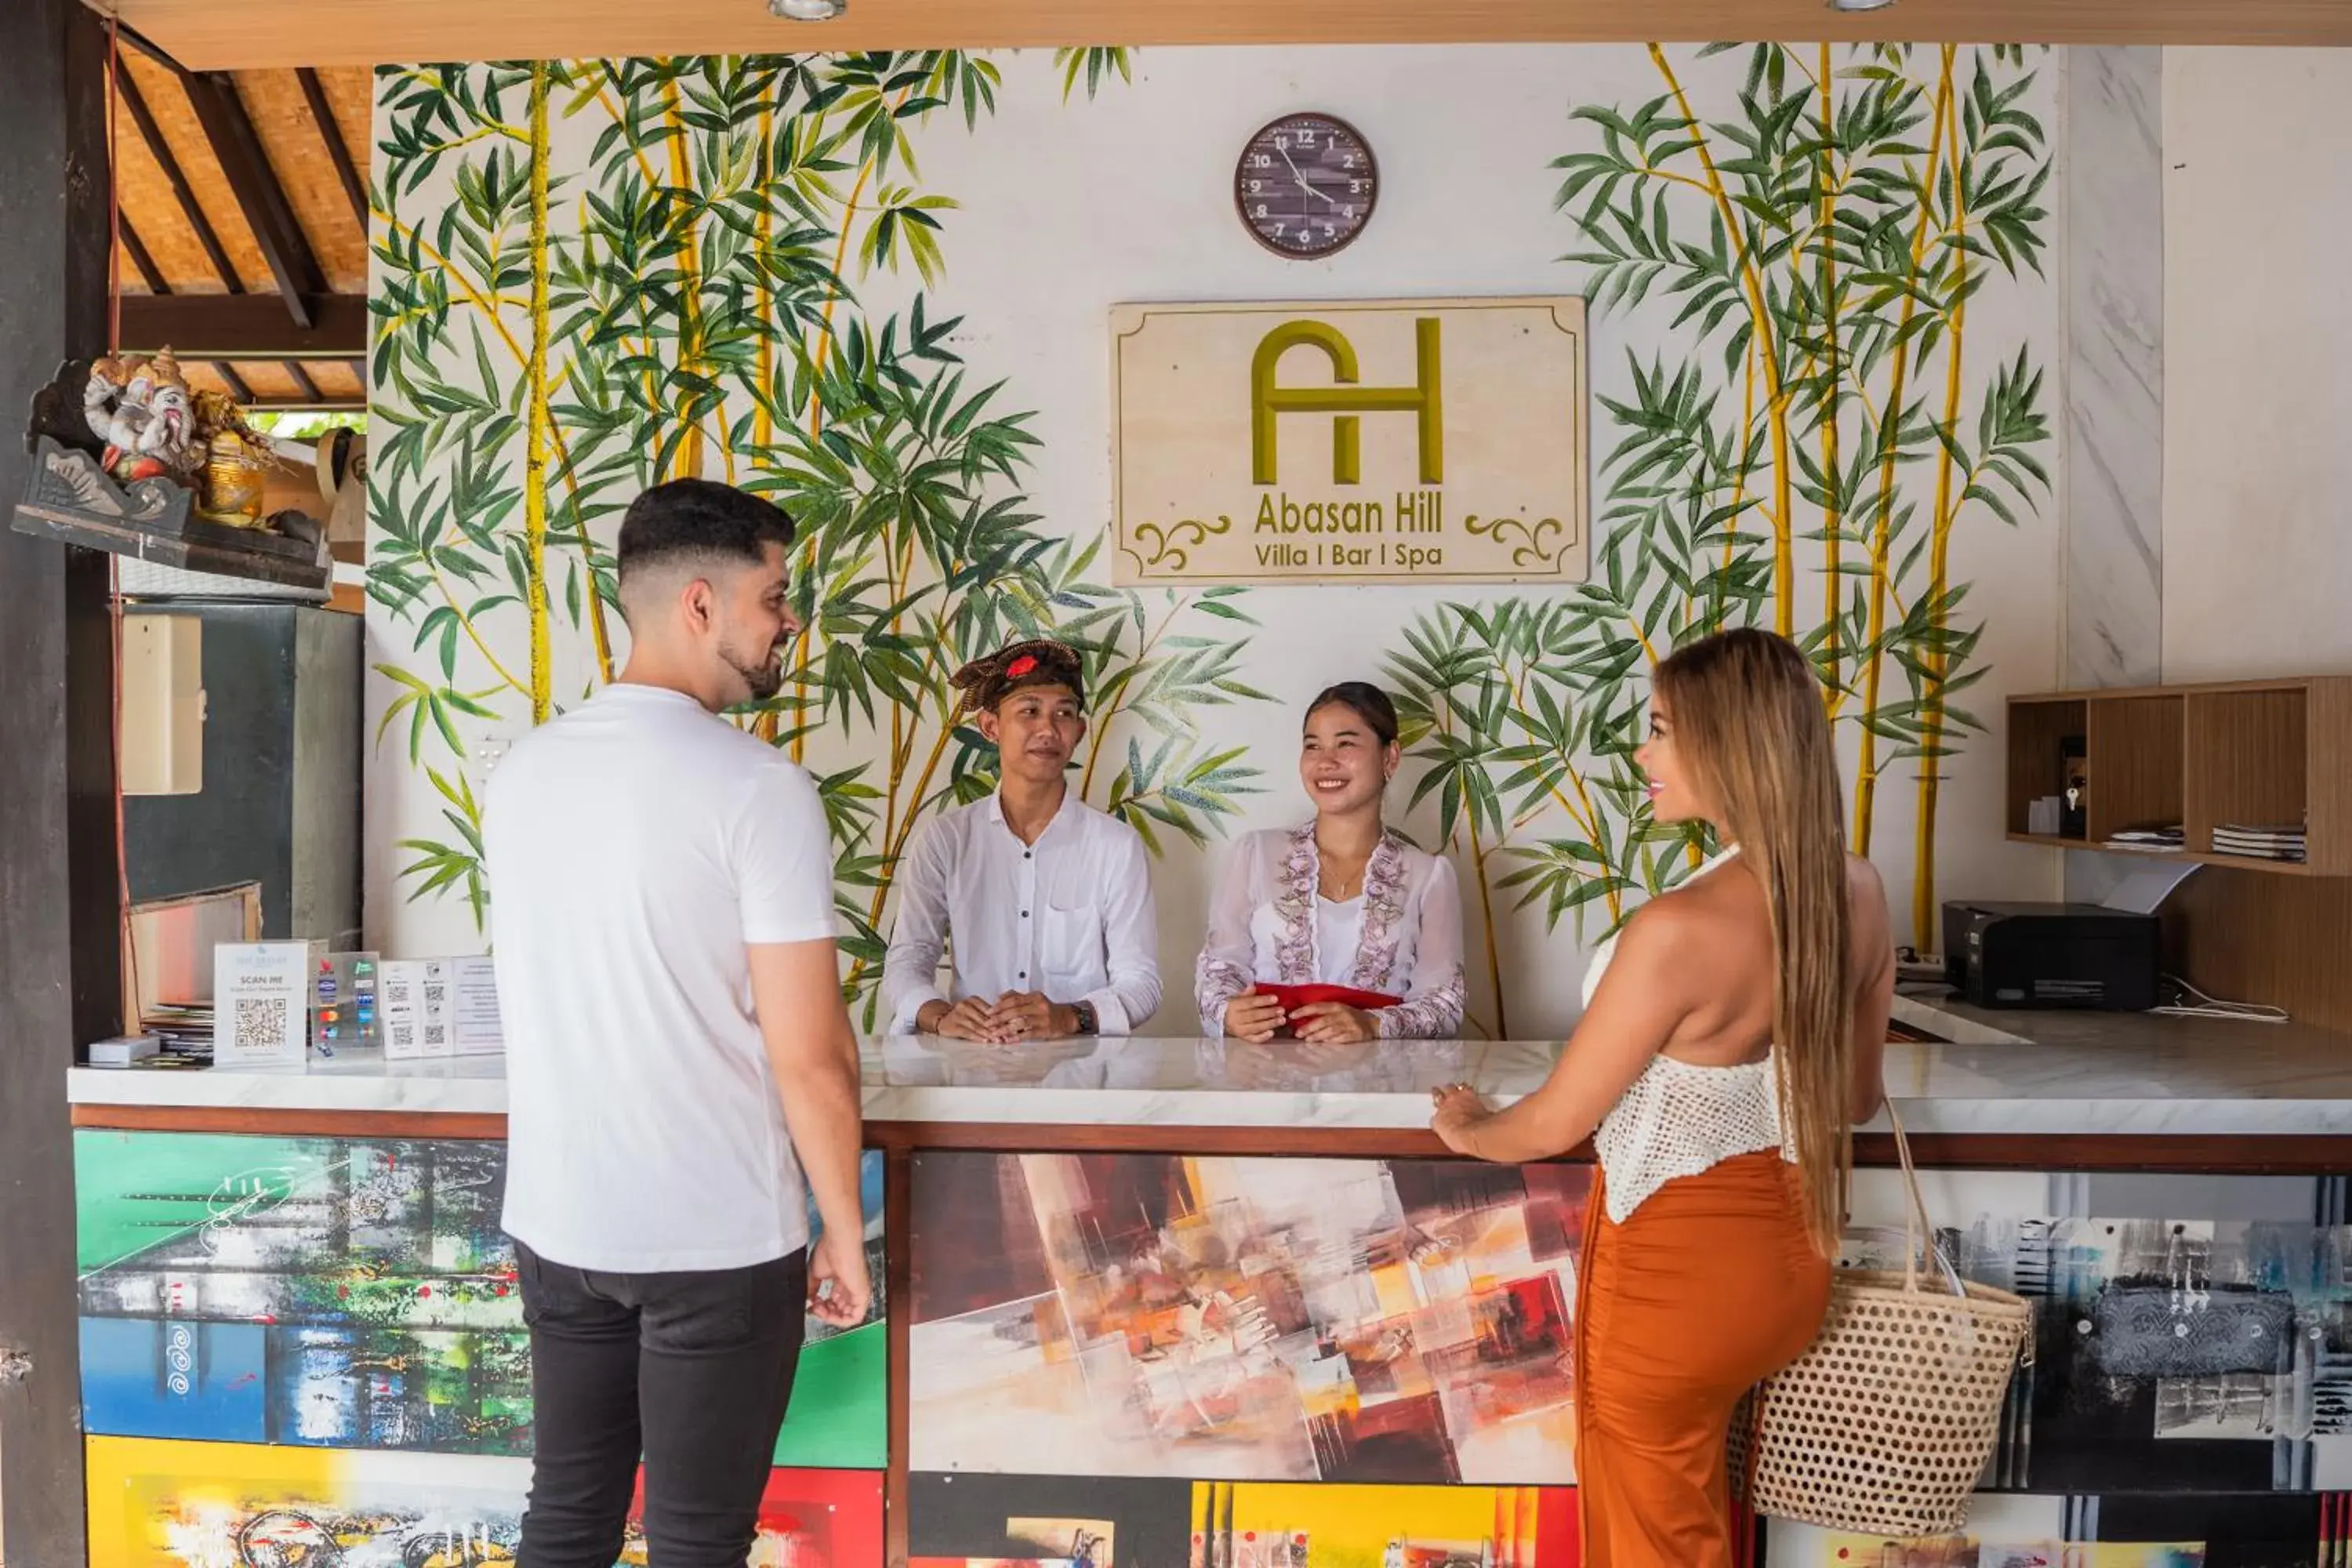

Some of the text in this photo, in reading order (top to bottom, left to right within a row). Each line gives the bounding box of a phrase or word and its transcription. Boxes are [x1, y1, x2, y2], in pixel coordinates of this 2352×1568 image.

[1297, 129, 1315, 143] 12
[1275, 136, 1288, 150] 11
[1327, 136, 1334, 150] 1
[1255, 155, 1271, 168] 10
[1343, 155, 1354, 169] 2
[1250, 180, 1261, 192] 9
[1349, 180, 1360, 193] 3
[1257, 205, 1268, 218] 8
[1342, 205, 1353, 218] 4
[1275, 223, 1286, 236] 7
[1325, 223, 1336, 236] 5
[1299, 230, 1310, 243] 6
[1251, 318, 1443, 485] AH
[1254, 491, 1442, 533] Abasan Hill
[1255, 543, 1308, 566] Villa
[1332, 543, 1372, 566] Bar
[1395, 543, 1442, 571] Spa
[240, 975, 267, 985] SCAN
